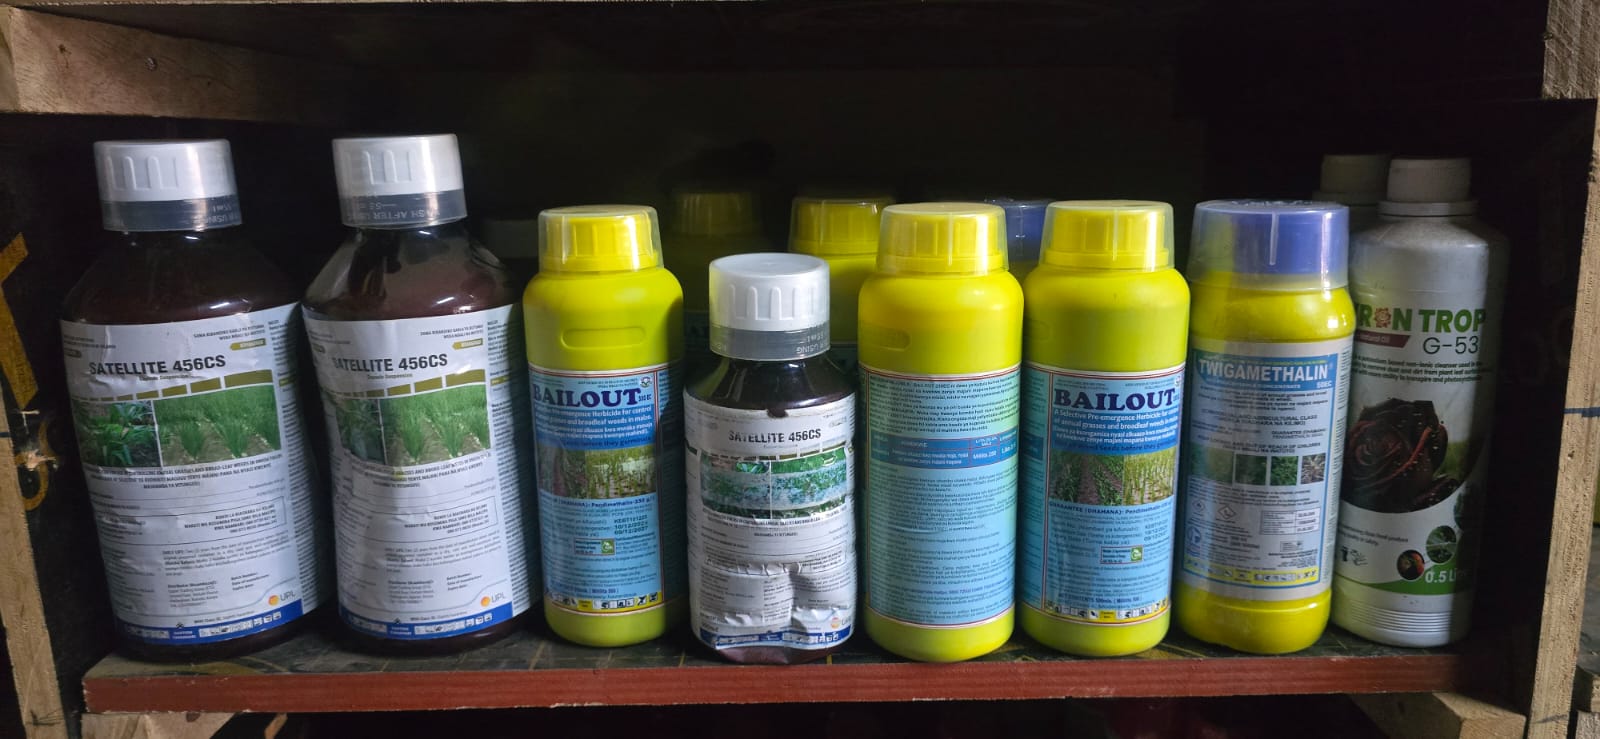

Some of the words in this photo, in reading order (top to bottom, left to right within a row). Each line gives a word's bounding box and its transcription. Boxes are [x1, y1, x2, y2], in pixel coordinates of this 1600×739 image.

[1417, 309, 1486, 333] TROP
[1422, 336, 1480, 354] G-53
[89, 361, 169, 376] SATELLITE
[172, 354, 226, 373] 456CS
[398, 353, 448, 370] 456CS
[1199, 359, 1328, 381] TWIGAMETHALIN
[533, 384, 641, 408] BAILOUT
[1054, 387, 1175, 411] BAILOUT
[1087, 413, 1136, 423] Pre-emergence
[1107, 422, 1121, 430] and
[727, 430, 785, 444] SATELLITE
[787, 427, 822, 442] 456CS
[1425, 569, 1448, 584] 0.5
[280, 589, 297, 602] UPL
